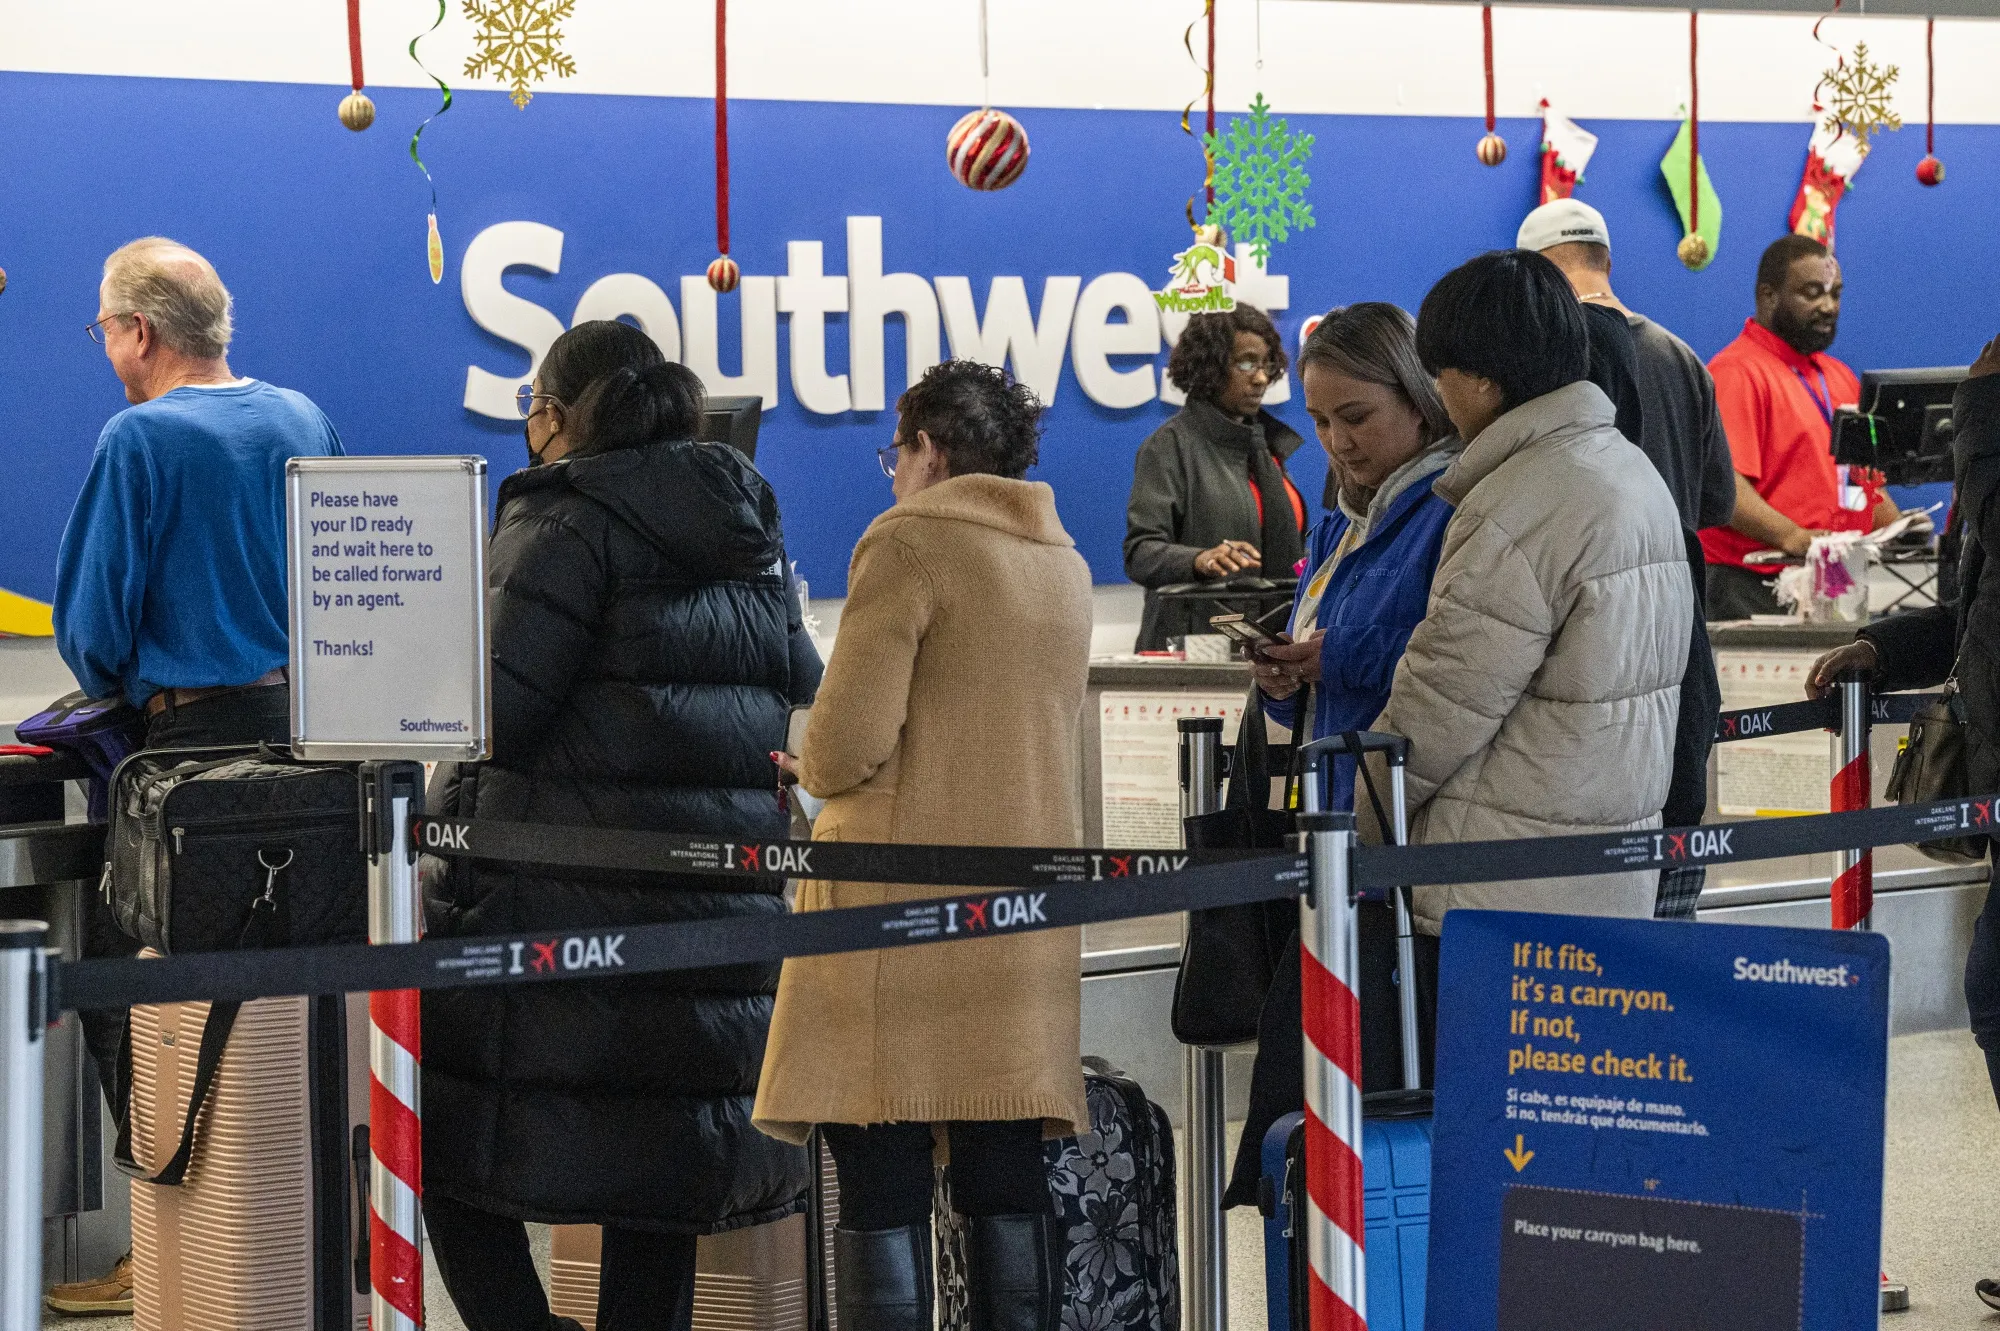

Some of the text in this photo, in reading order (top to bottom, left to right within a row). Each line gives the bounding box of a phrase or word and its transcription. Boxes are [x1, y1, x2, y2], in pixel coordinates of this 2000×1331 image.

[1153, 286, 1233, 313] Whoville
[311, 491, 398, 507] Please have
[311, 516, 413, 536] your ID ready
[312, 541, 433, 557] and wait here to
[312, 565, 442, 582] be called forward
[313, 591, 404, 611] by an agent.
[313, 640, 373, 656] Thanks!
[1871, 700, 1889, 719] AK
[400, 718, 463, 732] Southwest
[1740, 711, 1773, 734] OAK
[1931, 806, 1956, 814] OAKLAND
[1961, 803, 1969, 828] I
[426, 822, 470, 850] OAK
[689, 842, 719, 850] OAKLAND
[1654, 829, 1733, 860] I OAK
[670, 851, 719, 860] INTERNATIONAL
[724, 844, 813, 873] I OAK
[1053, 855, 1085, 863] OAKLAND
[1091, 855, 1103, 881] I
[1032, 864, 1085, 873] INTERNATIONAL
[945, 892, 1047, 933] I OAK
[509, 934, 625, 975] I OAK
[1513, 942, 1603, 976] If it fits,
[1733, 956, 1848, 987] Southwest
[1512, 975, 1674, 1015] it's a carryon.
[1511, 1010, 1580, 1043] If not,
[1509, 1043, 1693, 1082] please check it.
[1506, 1087, 1686, 1116] Si cabe, es equipaje de mano.
[1506, 1105, 1517, 1119] Si
[1519, 1108, 1539, 1122] no,
[1590, 1115, 1614, 1129] que
[1616, 1115, 1710, 1136] documentarlo.
[1514, 1219, 1702, 1253] Place your carryon bag here.
